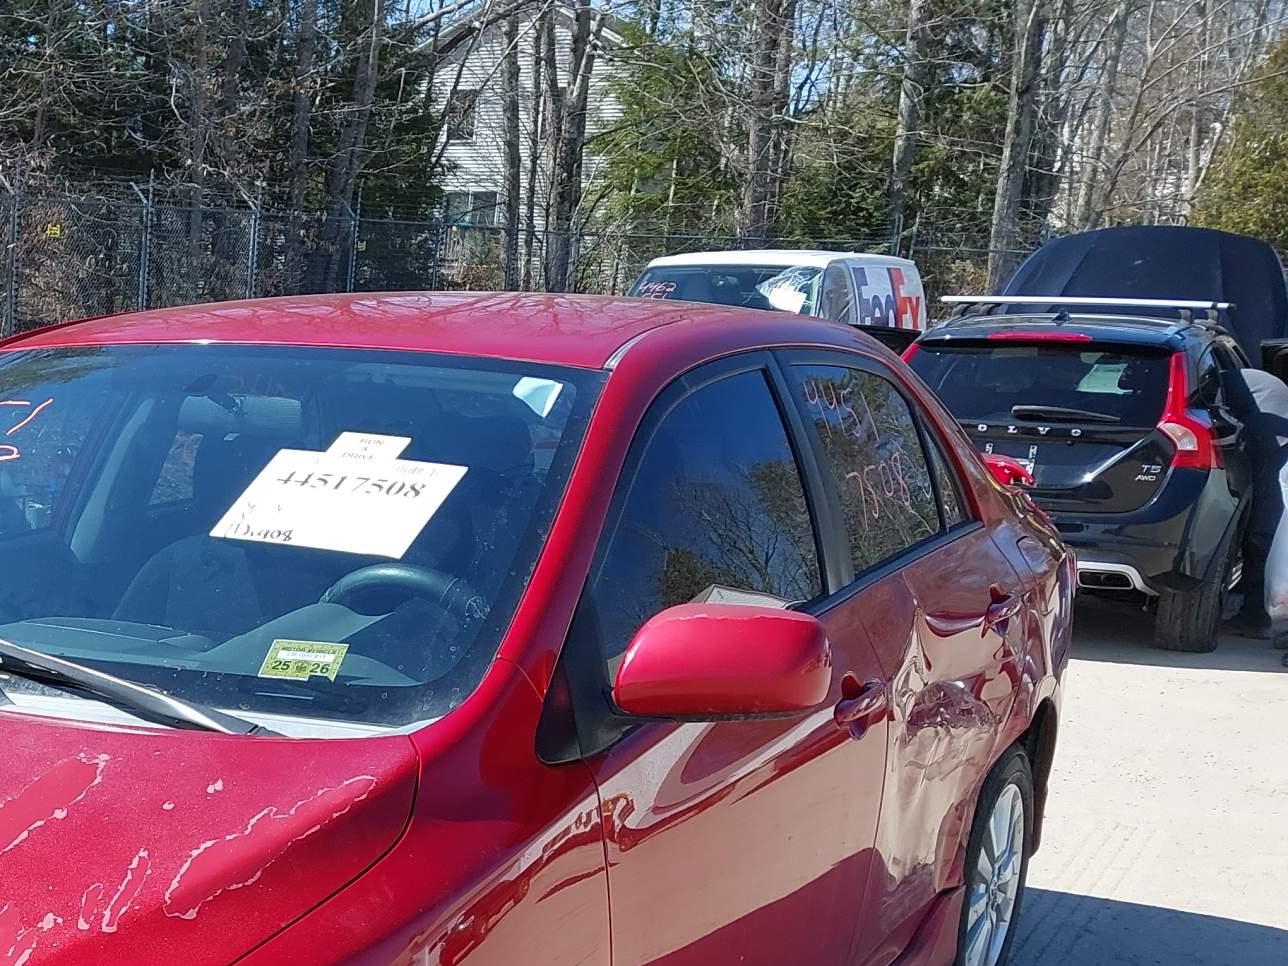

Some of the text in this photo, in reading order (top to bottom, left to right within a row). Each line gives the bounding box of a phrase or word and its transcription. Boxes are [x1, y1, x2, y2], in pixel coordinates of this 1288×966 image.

[803, 380, 880, 441] 4451
[977, 423, 1082, 437] OLVO
[1141, 464, 1162, 473] T5
[277, 470, 427, 499] 44517508
[846, 452, 911, 530] 7508
[271, 660, 331, 674] 25 26
